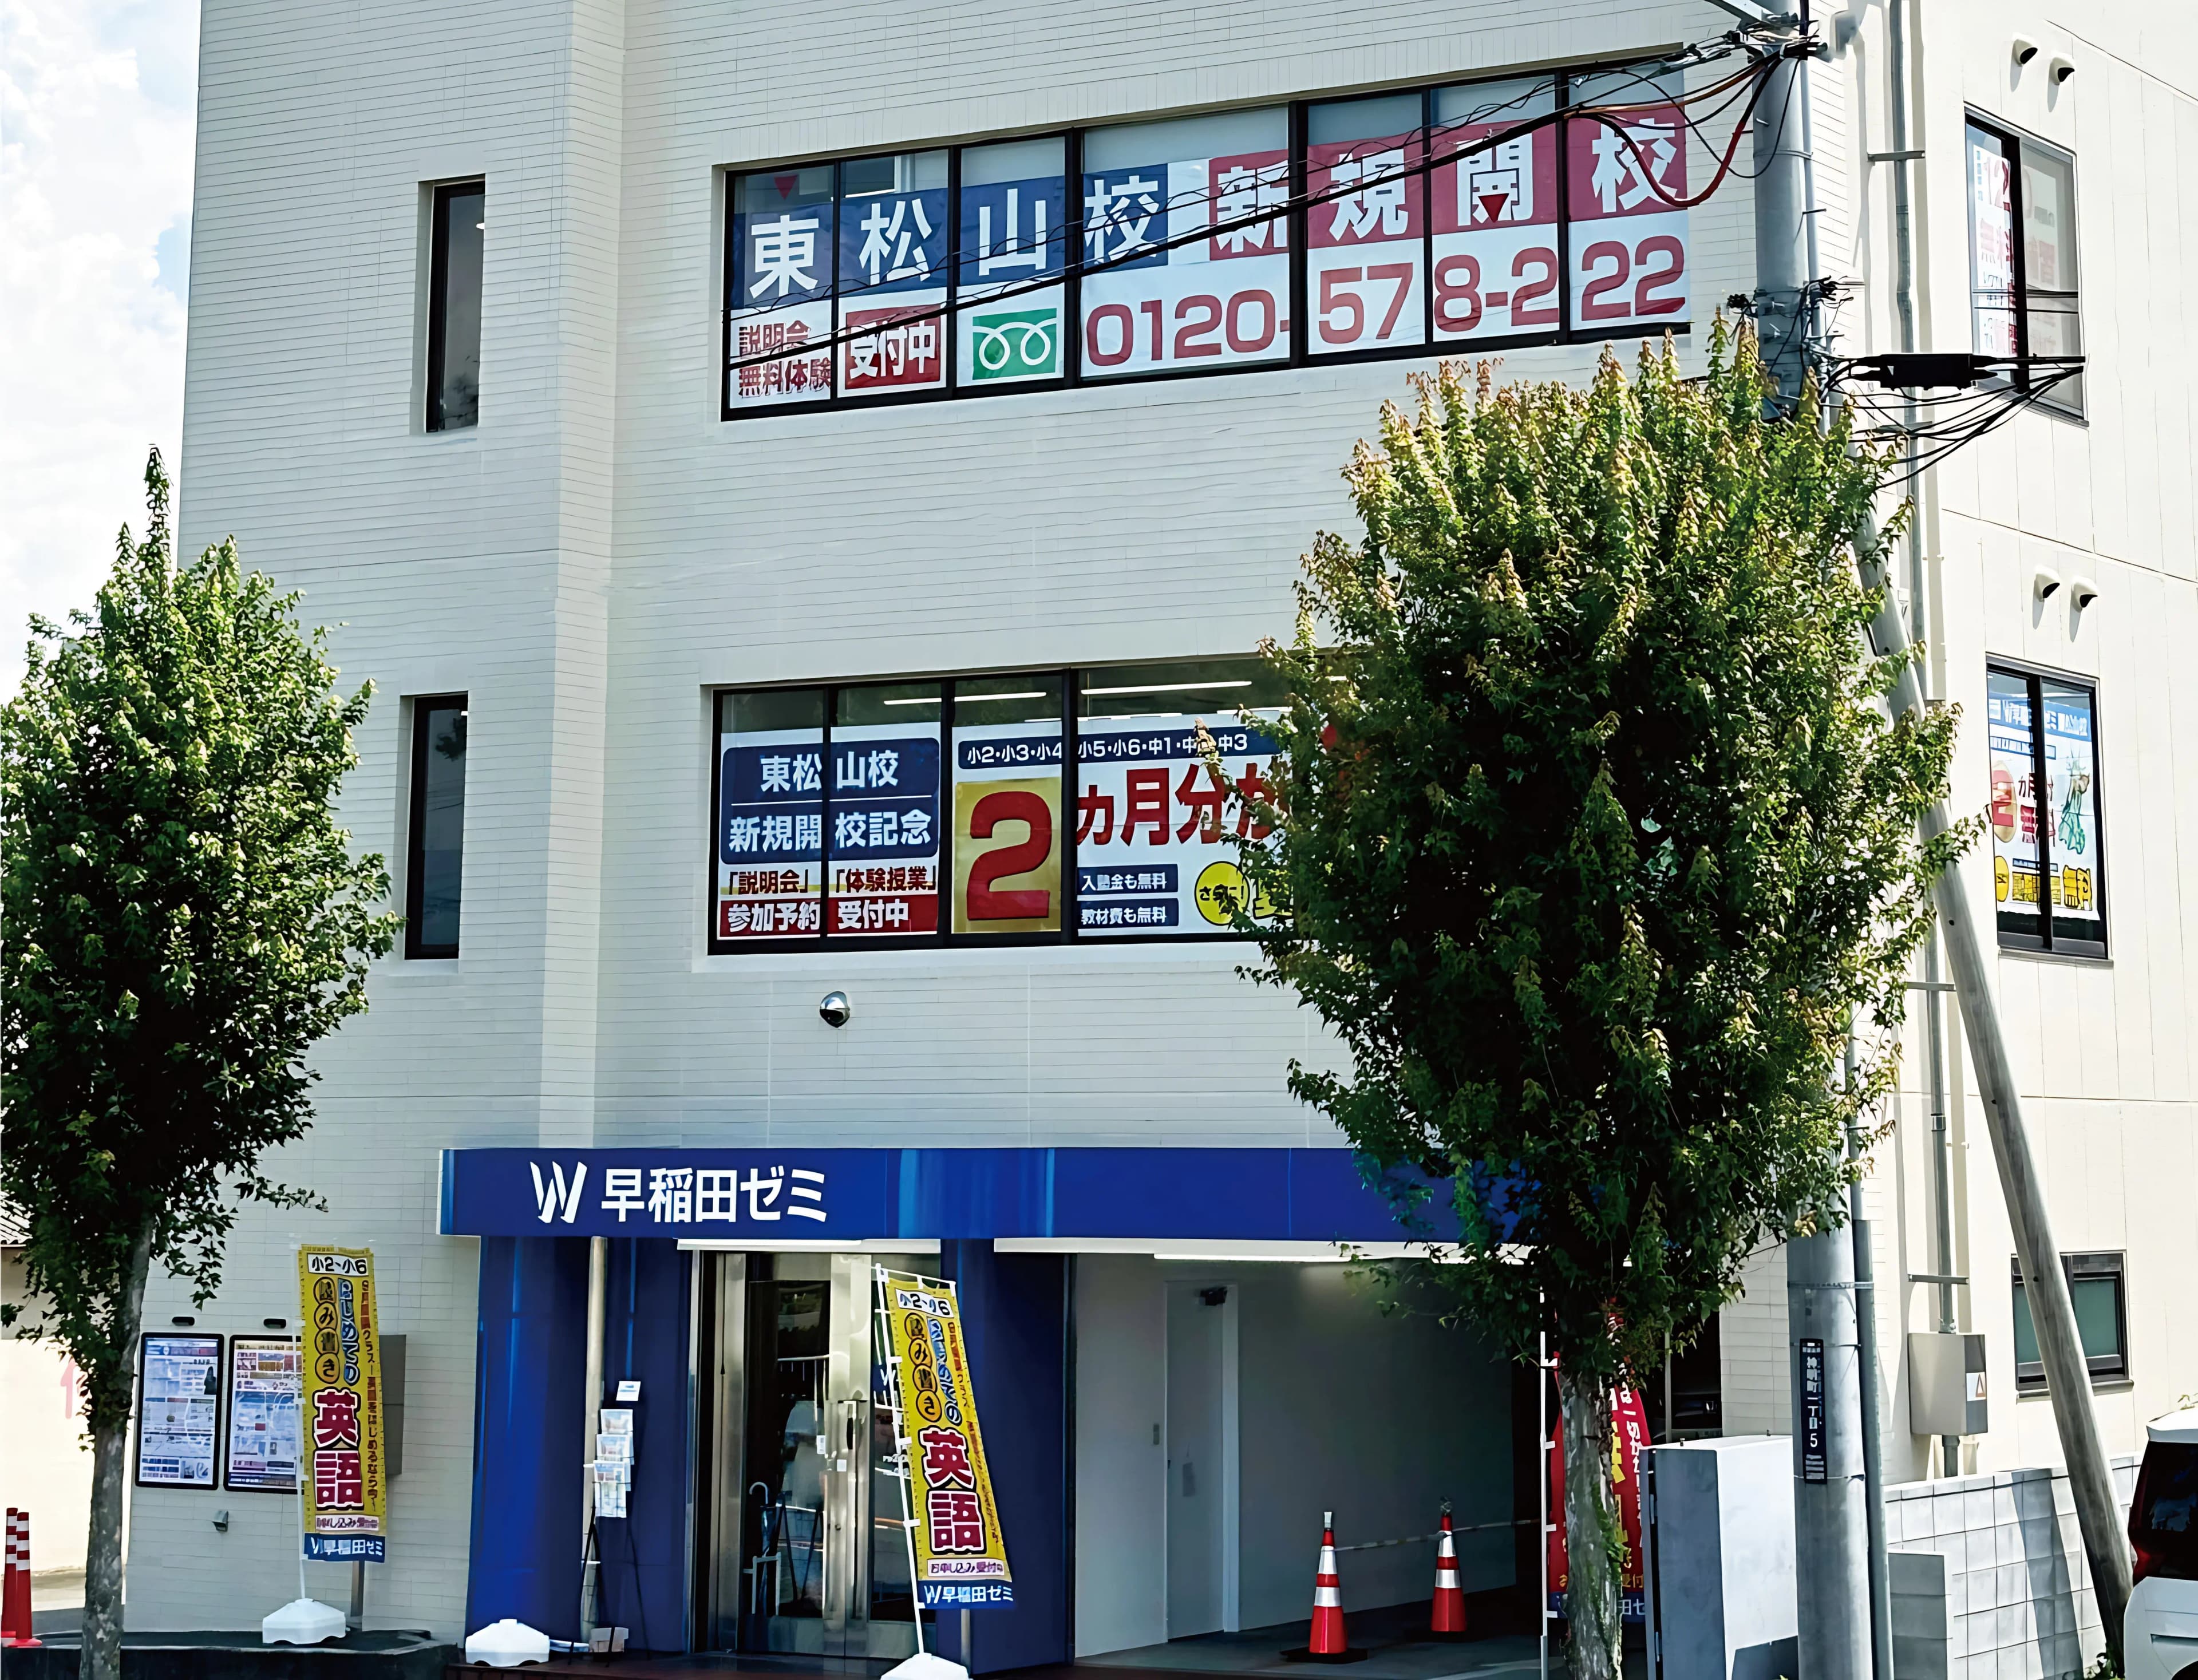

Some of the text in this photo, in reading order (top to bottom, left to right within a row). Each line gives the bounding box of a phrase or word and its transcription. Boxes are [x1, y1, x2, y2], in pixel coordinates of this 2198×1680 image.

[850, 321, 935, 379] 受付中
[761, 750, 899, 792] 東松山校
[729, 809, 931, 853] 新規開校記念
[728, 899, 909, 932] 参加予約 受付中
[602, 1165, 827, 1223] 早稲田ゼミ
[314, 1389, 363, 1507] 英語
[919, 1427, 985, 1551] 英語
